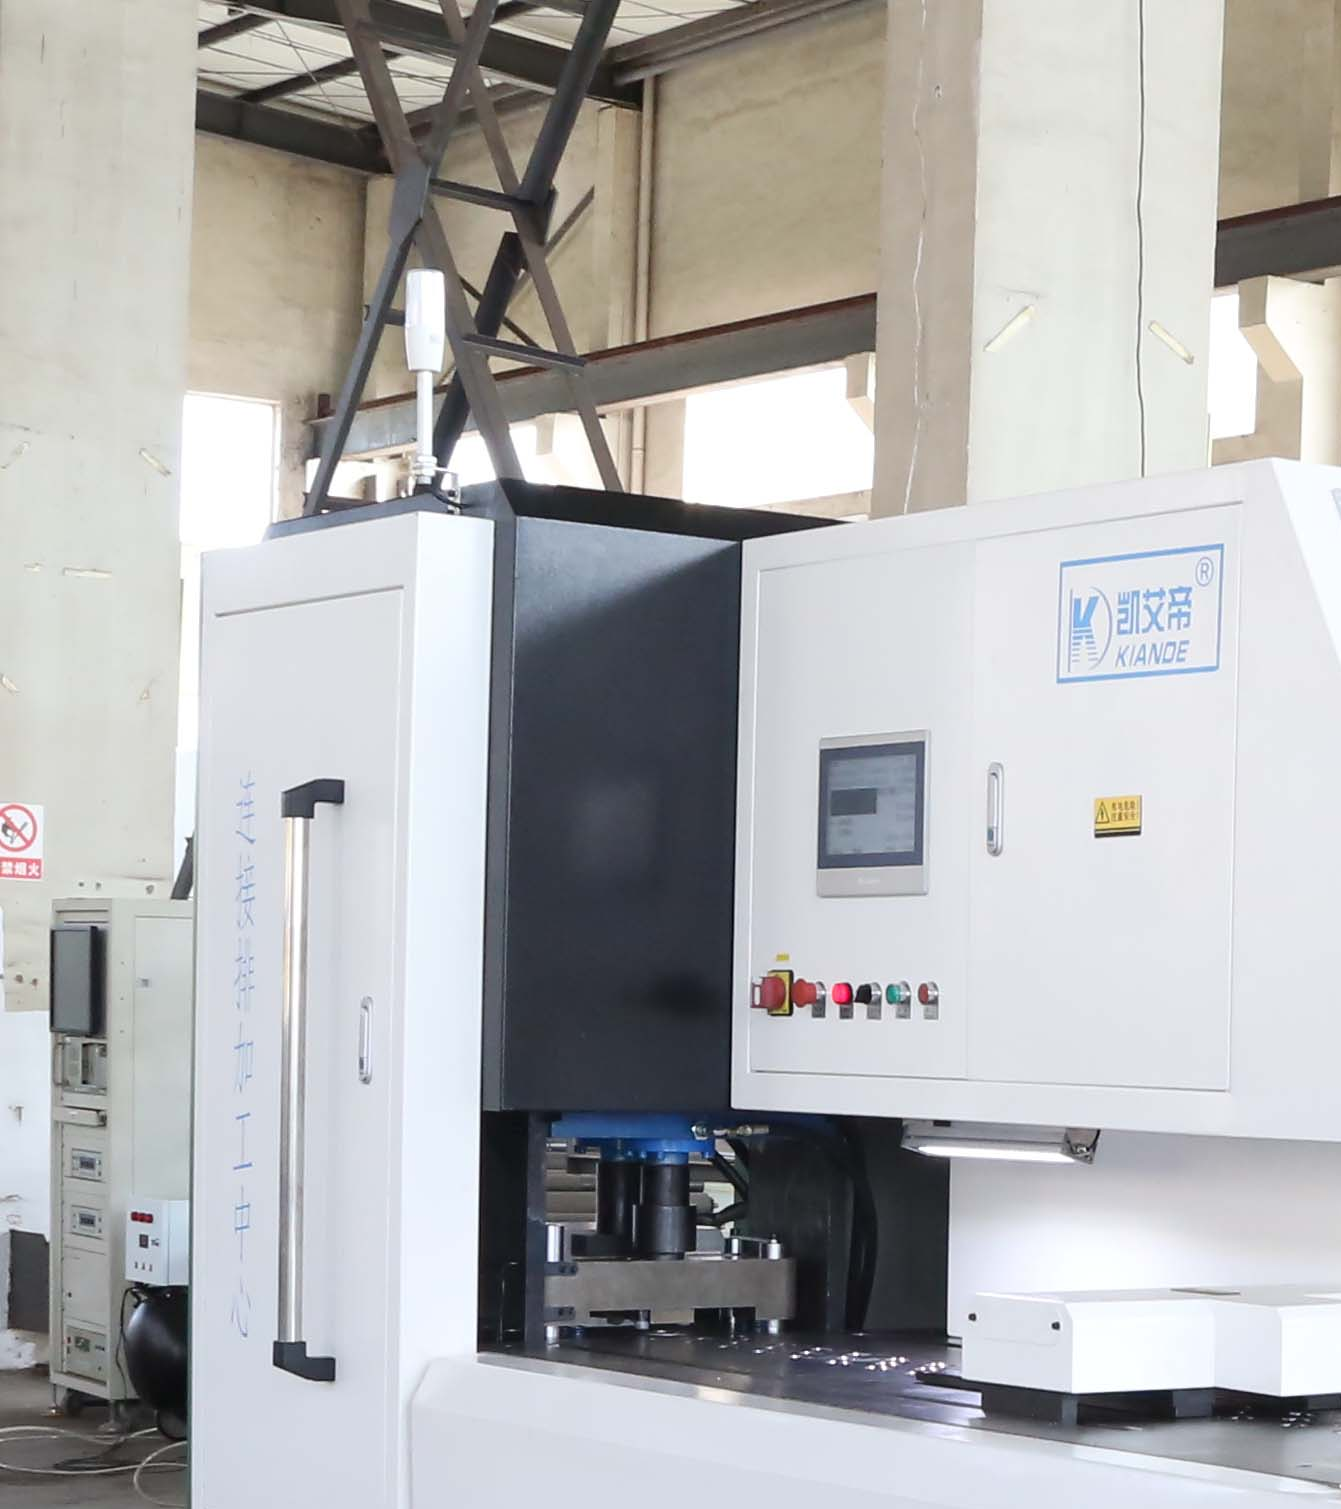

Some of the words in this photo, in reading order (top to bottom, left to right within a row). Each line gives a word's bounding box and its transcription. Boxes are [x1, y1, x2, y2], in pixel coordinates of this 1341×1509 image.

[1117, 585, 1193, 635] 凯艾帝
[1115, 639, 1191, 669] KIANDE
